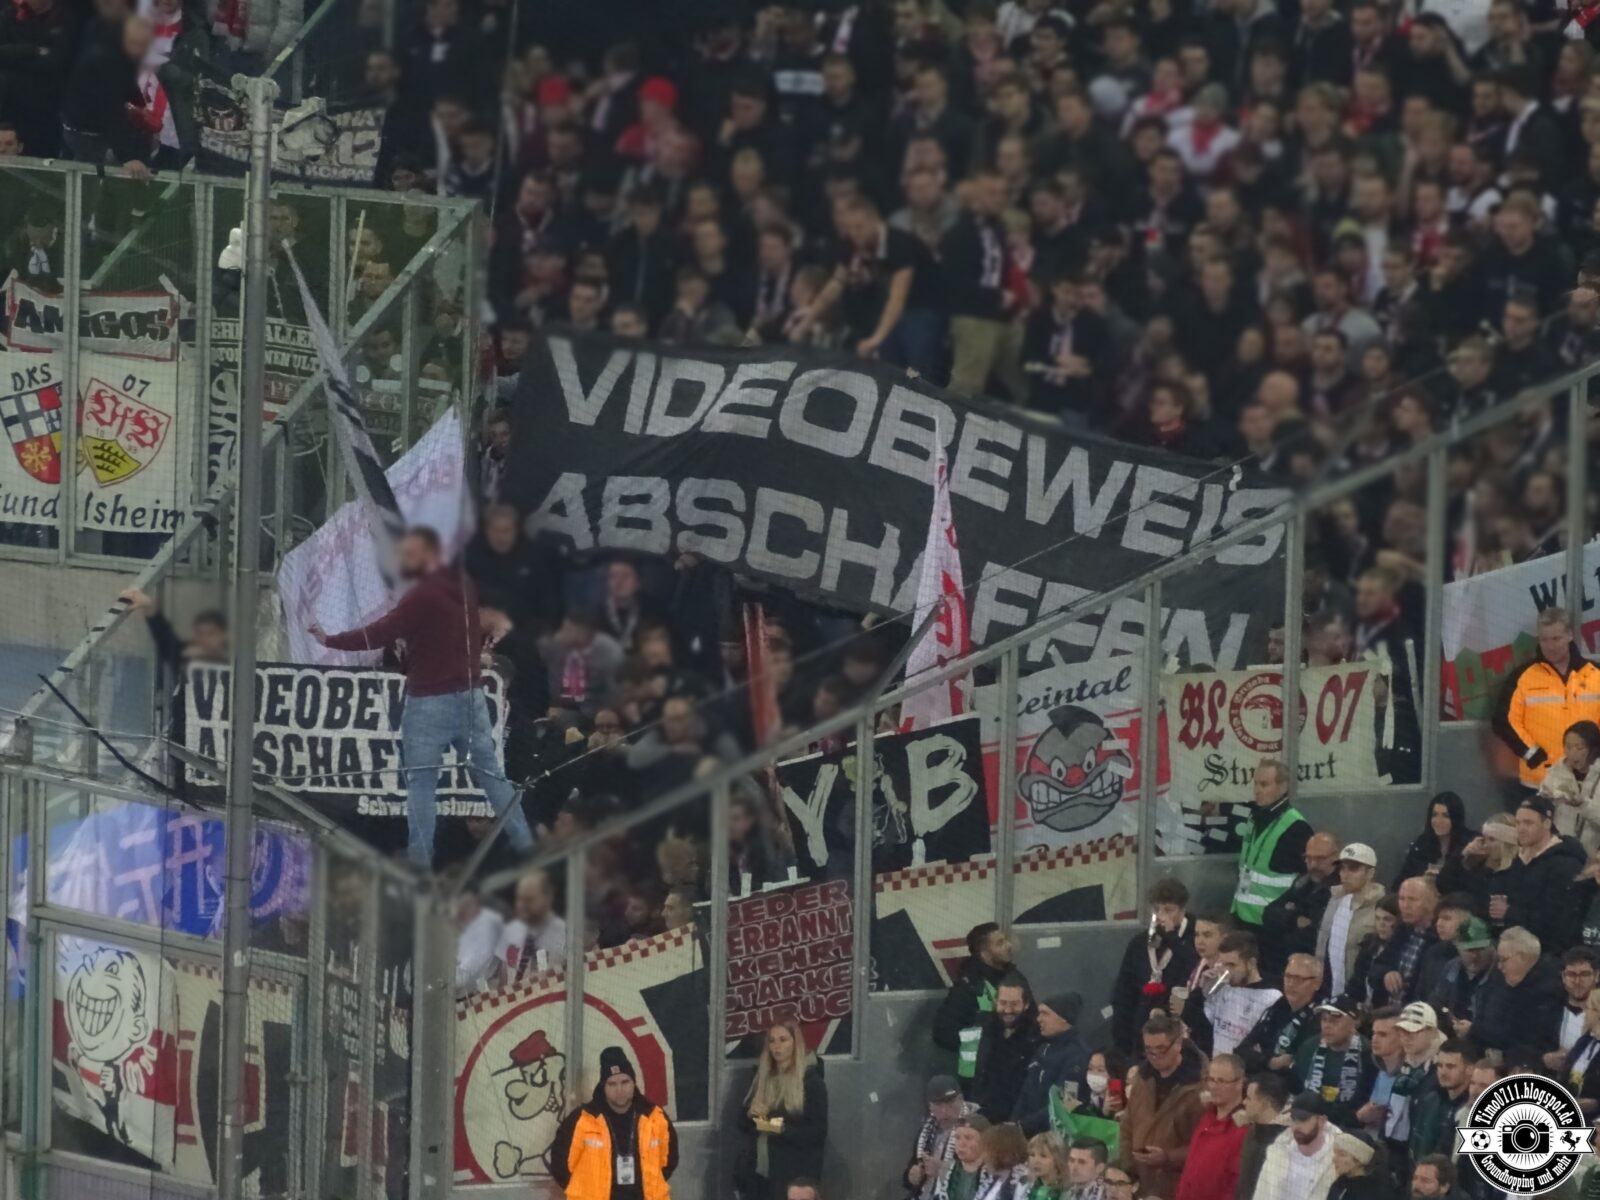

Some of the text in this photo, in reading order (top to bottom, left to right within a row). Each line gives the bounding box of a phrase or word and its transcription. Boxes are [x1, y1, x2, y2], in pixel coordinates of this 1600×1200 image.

[11, 363, 151, 397] DKS 07
[547, 336, 1291, 567] VIDEOBEWEIS
[0, 484, 186, 530] undlsheim
[191, 666, 502, 734] VIEOBES
[1316, 669, 1370, 746] 07
[1198, 753, 1337, 792] Stuart
[357, 795, 487, 817] Schwsturm
[727, 902, 855, 959] ERBANNT
